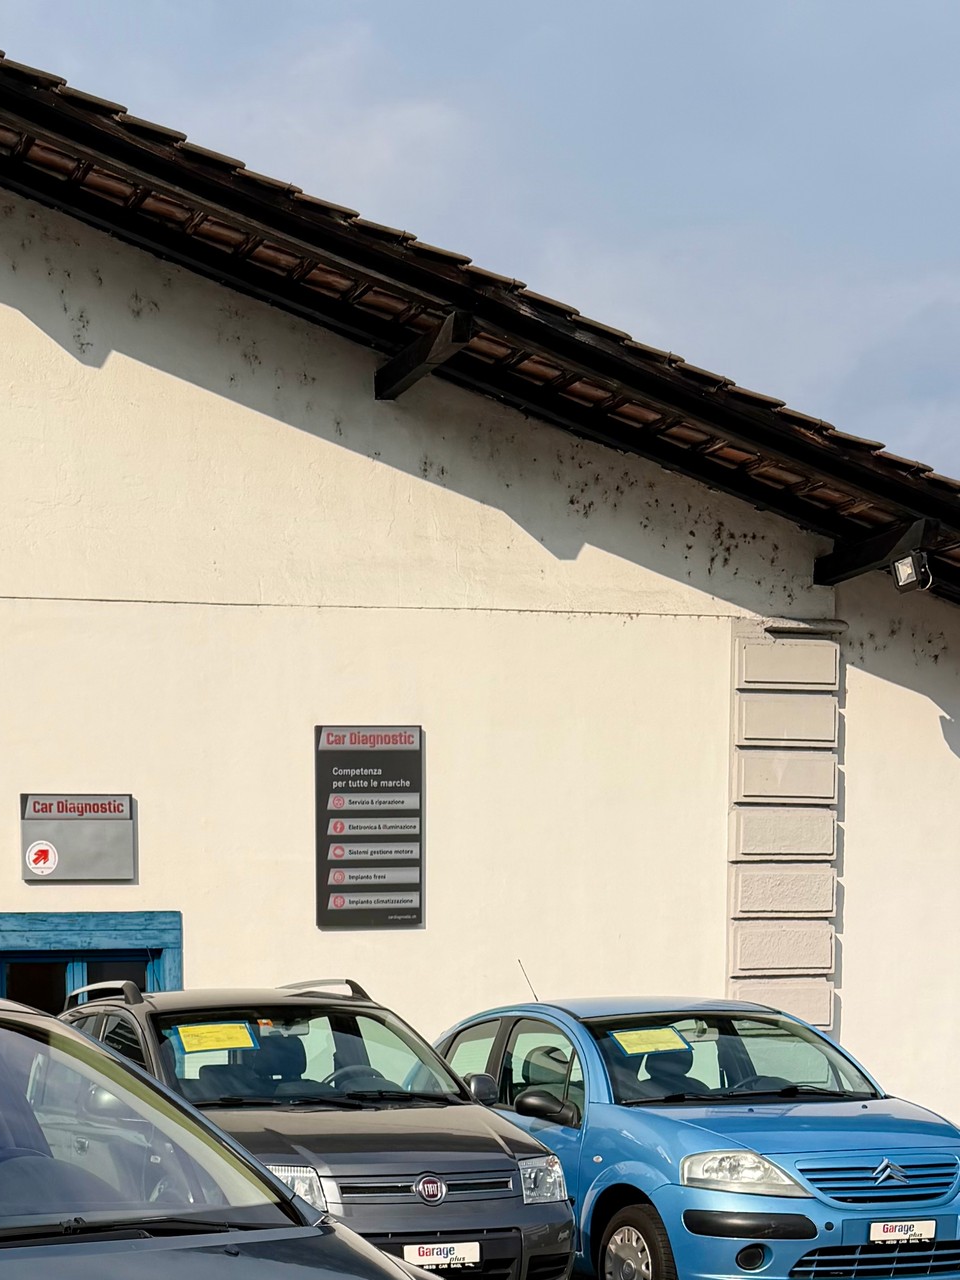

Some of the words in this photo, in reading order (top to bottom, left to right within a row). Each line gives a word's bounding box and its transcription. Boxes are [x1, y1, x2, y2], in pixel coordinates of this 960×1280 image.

[326, 732, 346, 745] Car
[349, 731, 415, 748] Diagnostic
[332, 767, 382, 777] Competenza
[332, 780, 346, 789] per
[348, 779, 369, 788] tutte
[370, 779, 378, 787] le
[380, 779, 410, 788] marche
[32, 800, 54, 813] Car
[57, 799, 125, 817] Diagnostic
[882, 1223, 915, 1235] Garage
[417, 1246, 455, 1259] Garage
[449, 1255, 466, 1264] plus
